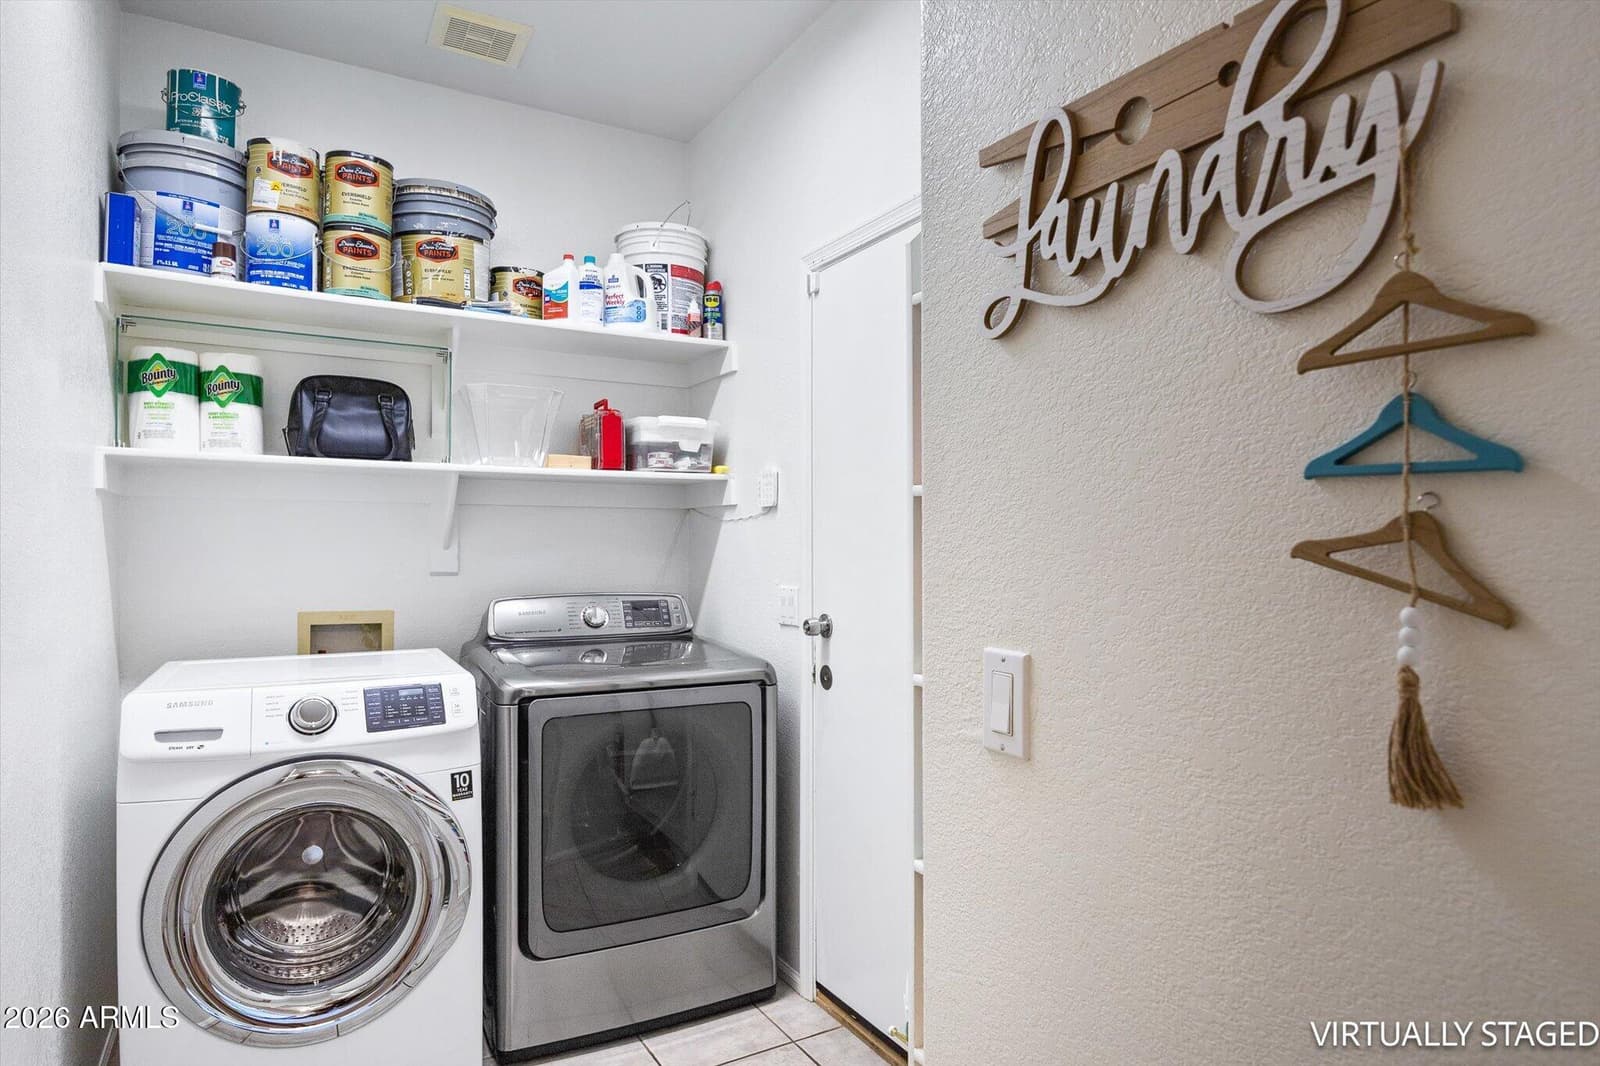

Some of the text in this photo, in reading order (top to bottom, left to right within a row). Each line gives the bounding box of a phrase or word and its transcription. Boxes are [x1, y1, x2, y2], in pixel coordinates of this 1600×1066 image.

[342, 172, 372, 184] PAINTS
[982, 0, 1444, 340] Laundry
[255, 241, 295, 258] 200
[342, 246, 373, 257] PAINTS
[423, 249, 452, 258] PAINTS
[141, 367, 177, 385] Bounty
[206, 380, 241, 396] Bounty
[166, 699, 214, 709] SAMSUNG
[453, 772, 470, 788] 10
